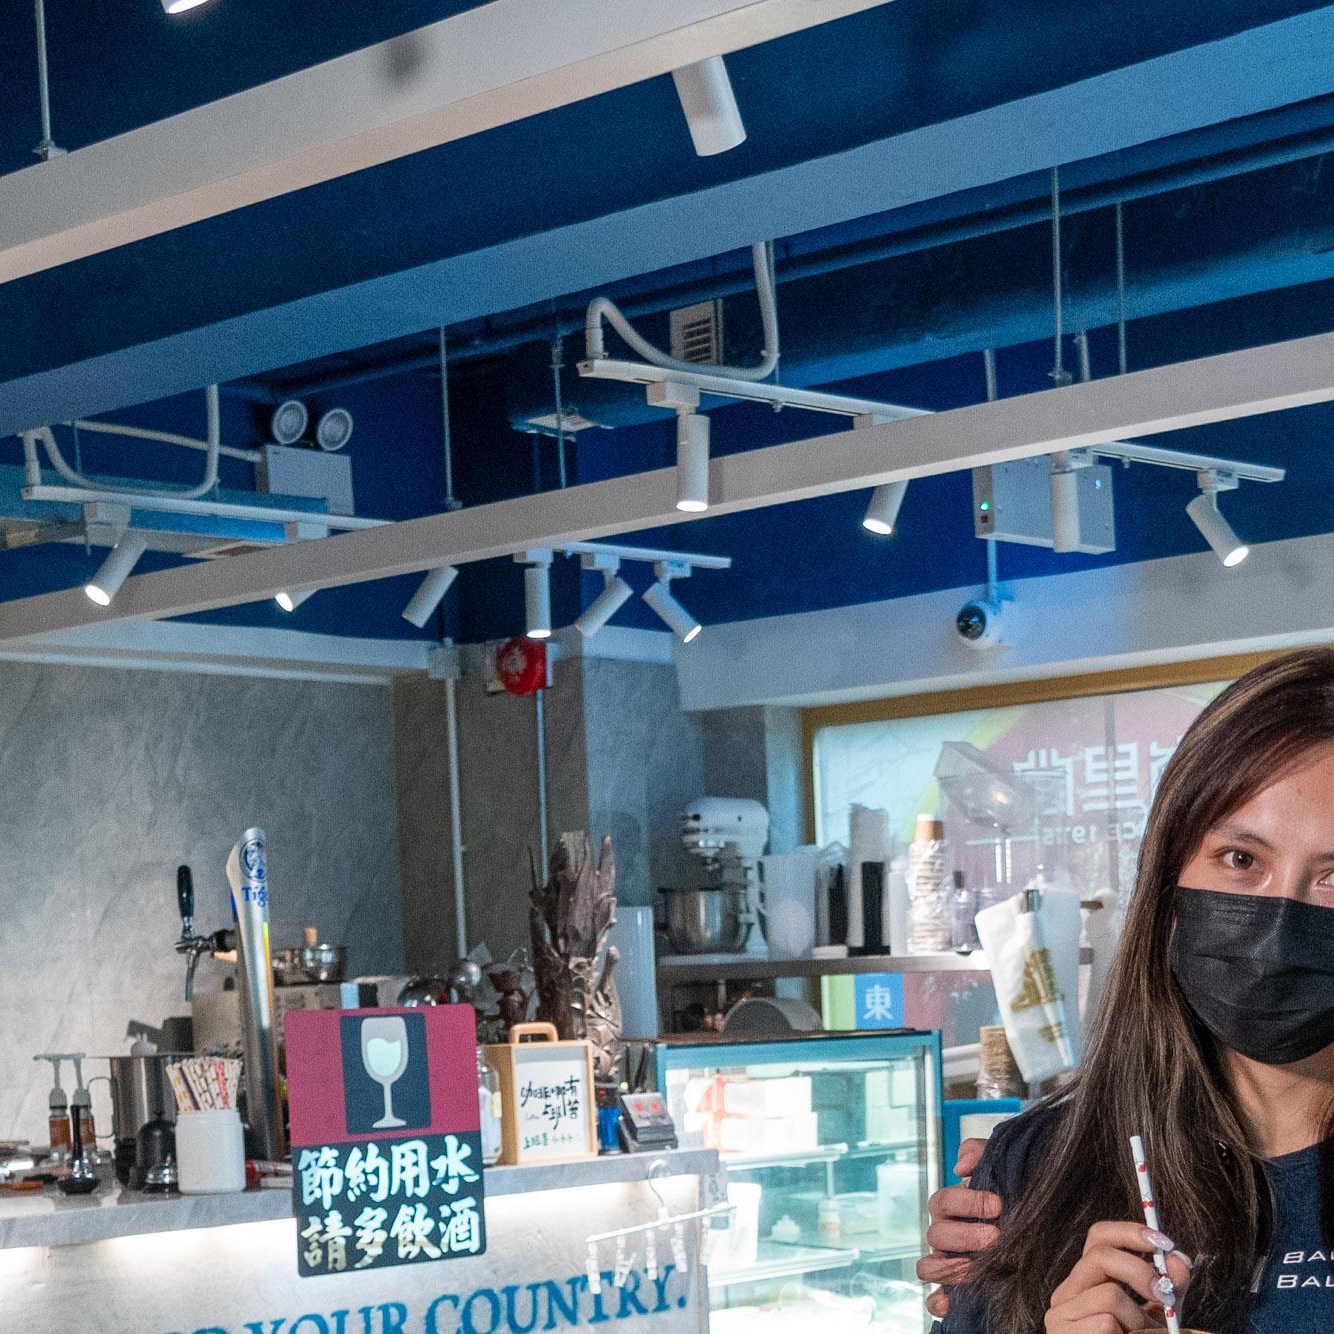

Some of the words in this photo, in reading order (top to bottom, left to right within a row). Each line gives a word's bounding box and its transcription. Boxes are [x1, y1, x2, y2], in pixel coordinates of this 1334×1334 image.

[863, 984, 894, 1021] 東
[297, 1134, 480, 1211] 節約用水
[300, 1196, 482, 1271] 請多飲酒
